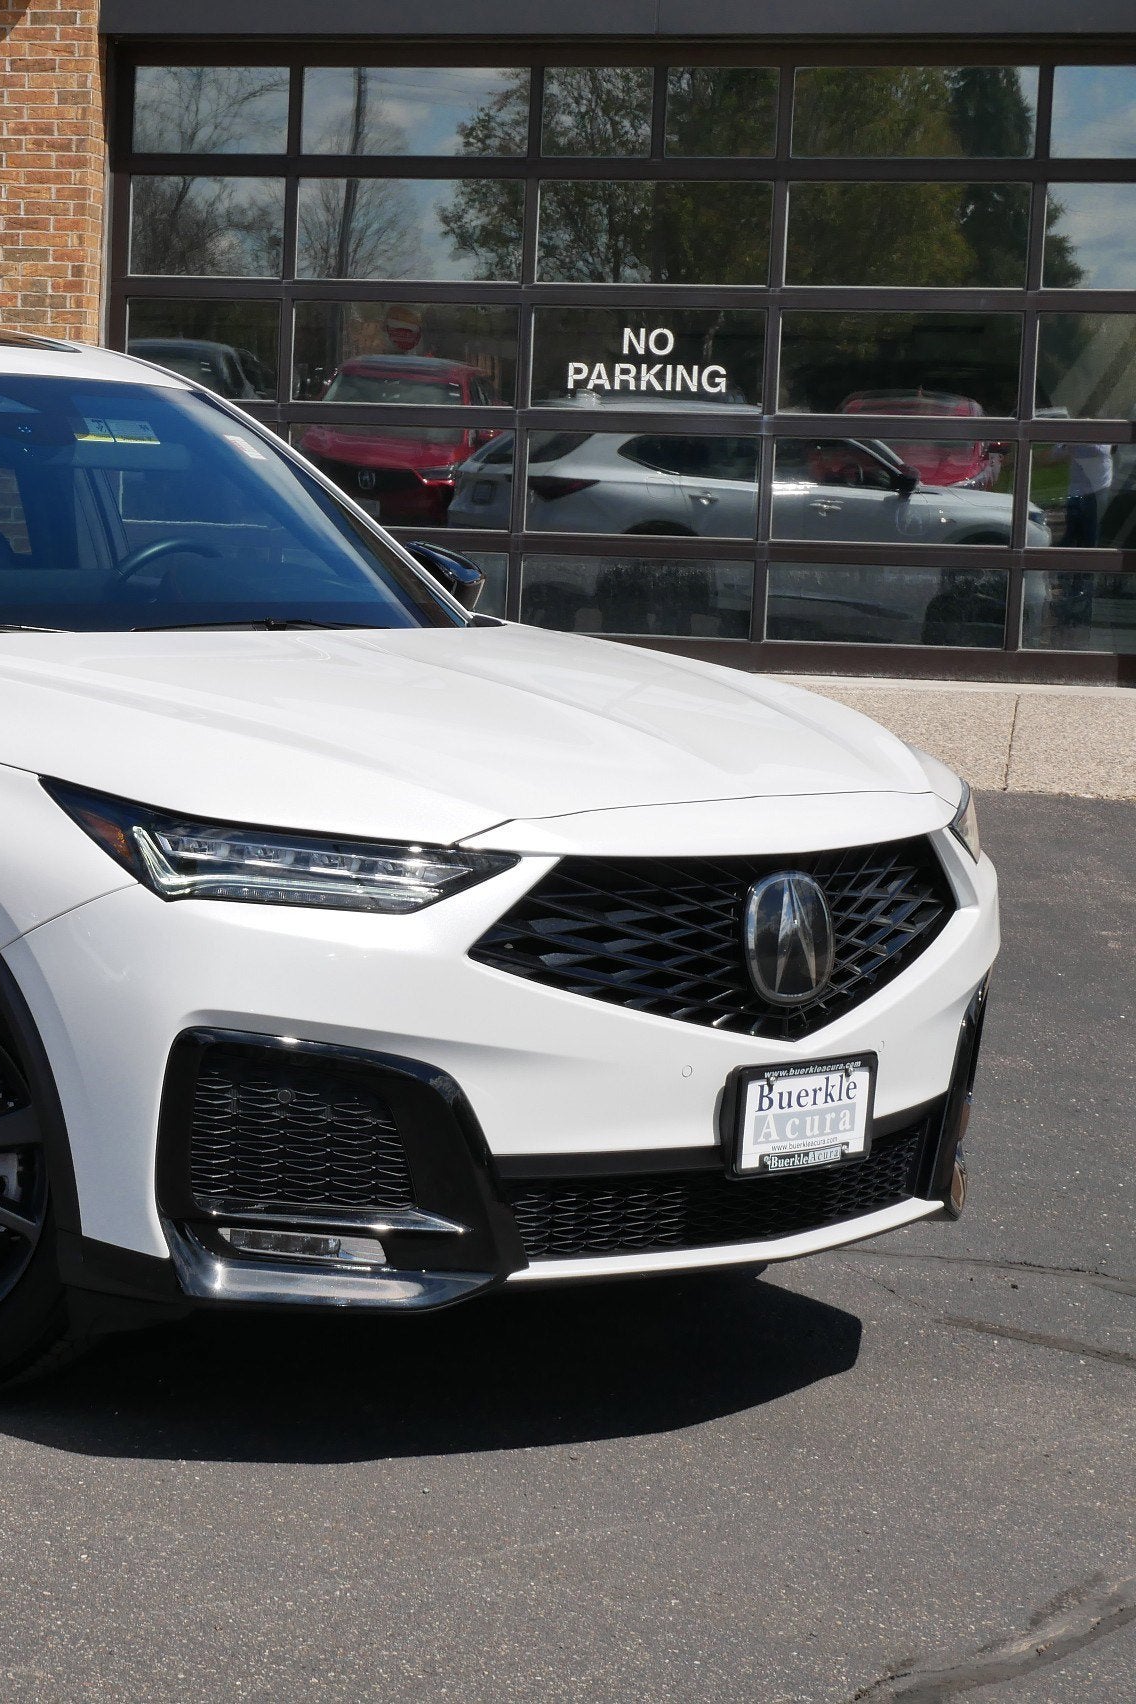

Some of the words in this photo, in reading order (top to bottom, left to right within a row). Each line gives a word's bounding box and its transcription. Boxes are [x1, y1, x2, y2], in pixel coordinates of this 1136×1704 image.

[623, 327, 675, 356] NO
[567, 362, 727, 393] PARKING
[755, 1073, 858, 1113] Buerkle
[757, 1108, 852, 1143] Acura
[771, 1136, 838, 1151] www.buerkleacura.com
